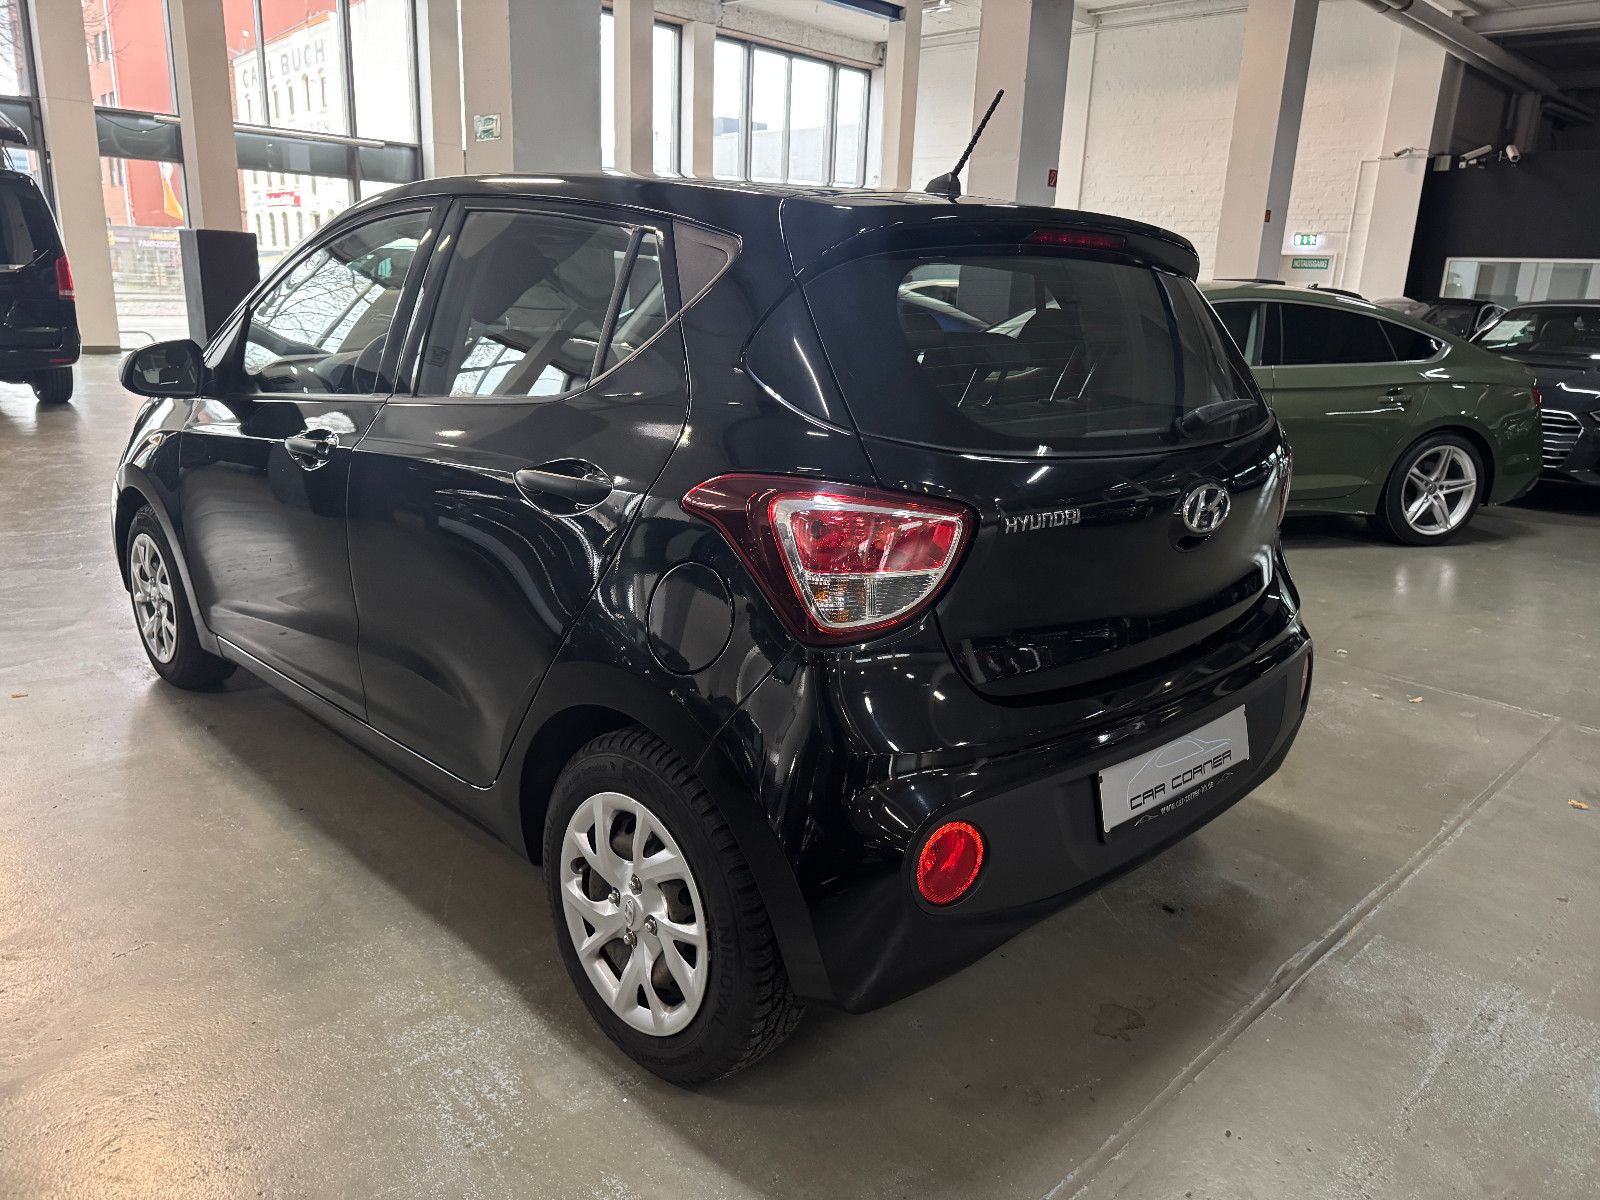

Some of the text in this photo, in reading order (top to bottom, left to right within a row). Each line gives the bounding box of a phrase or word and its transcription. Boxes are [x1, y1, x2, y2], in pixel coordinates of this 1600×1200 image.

[243, 38, 325, 89] CAL BUCH
[1005, 509, 1081, 534] HYUNDAI
[1130, 750, 1232, 810] CAR CORNER
